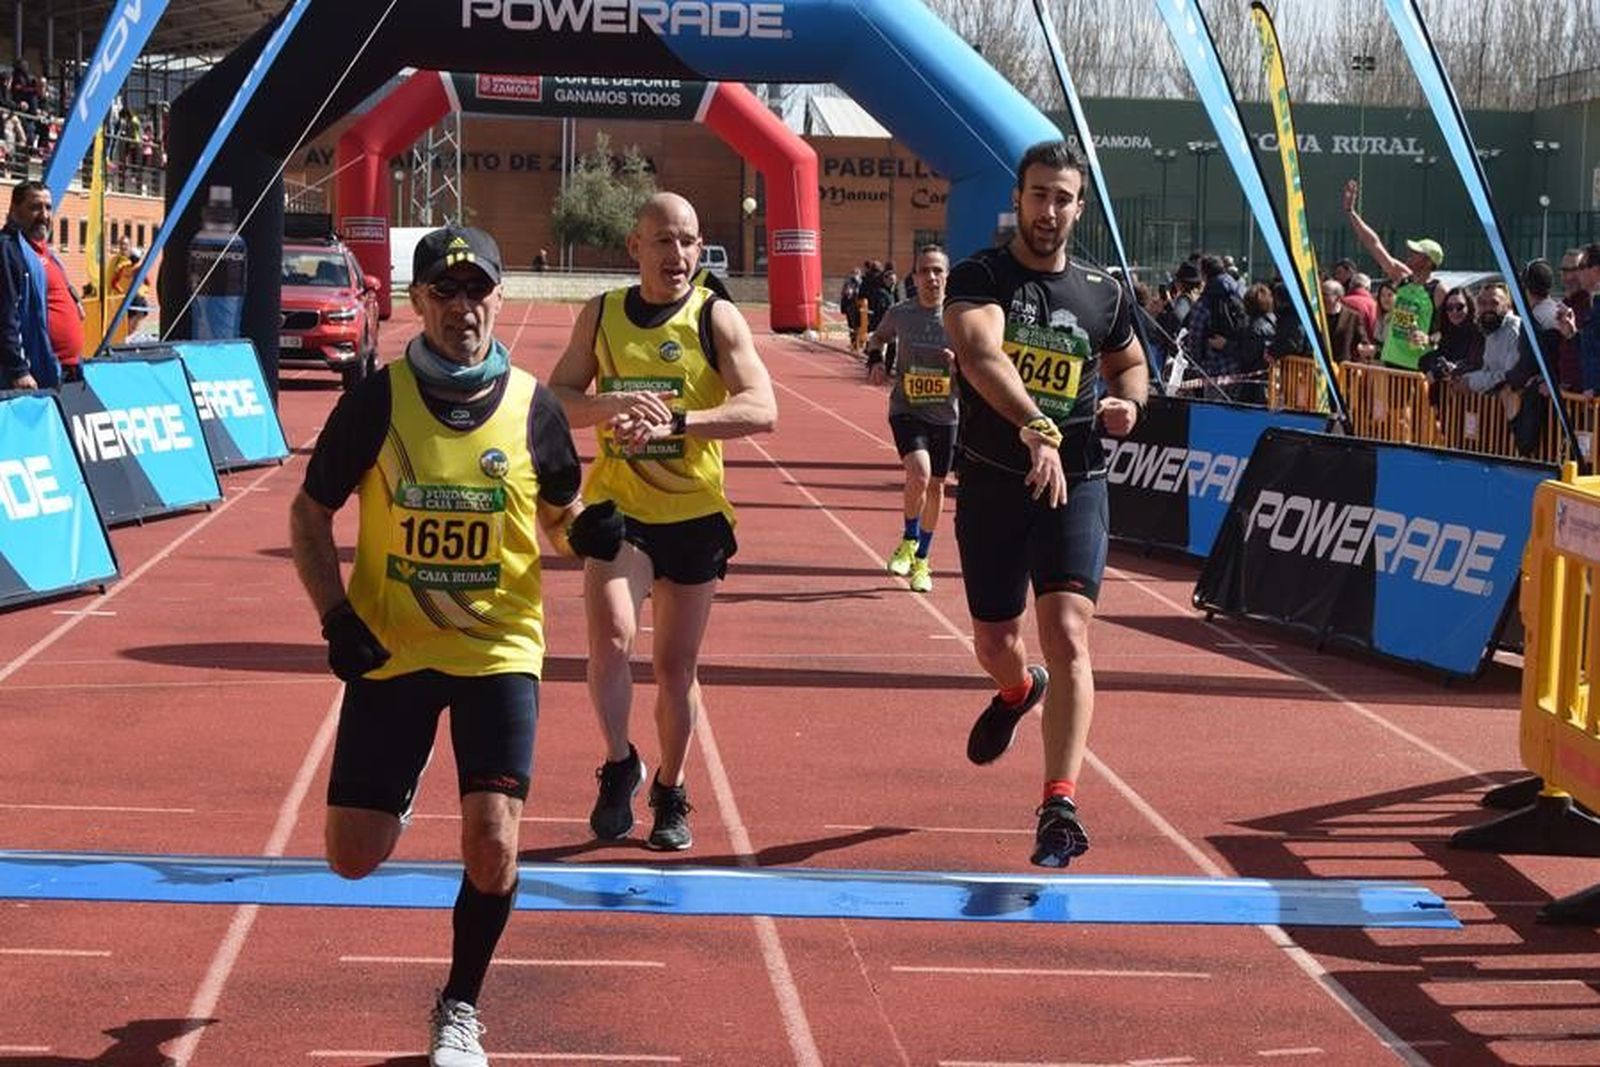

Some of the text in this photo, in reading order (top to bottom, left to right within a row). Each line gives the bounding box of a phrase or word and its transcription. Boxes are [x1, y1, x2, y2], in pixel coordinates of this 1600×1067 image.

[462, 0, 784, 38] POWERADE
[554, 88, 681, 106] GANAMOS TODOS
[1091, 134, 1153, 149] ZAMORA
[1332, 135, 1425, 155] RURAL
[824, 158, 940, 178] PABELL
[909, 378, 944, 395] 1905
[400, 515, 490, 560] 1650
[1243, 489, 1506, 595] POWERADE
[416, 569, 497, 584] CAJA RURAL
